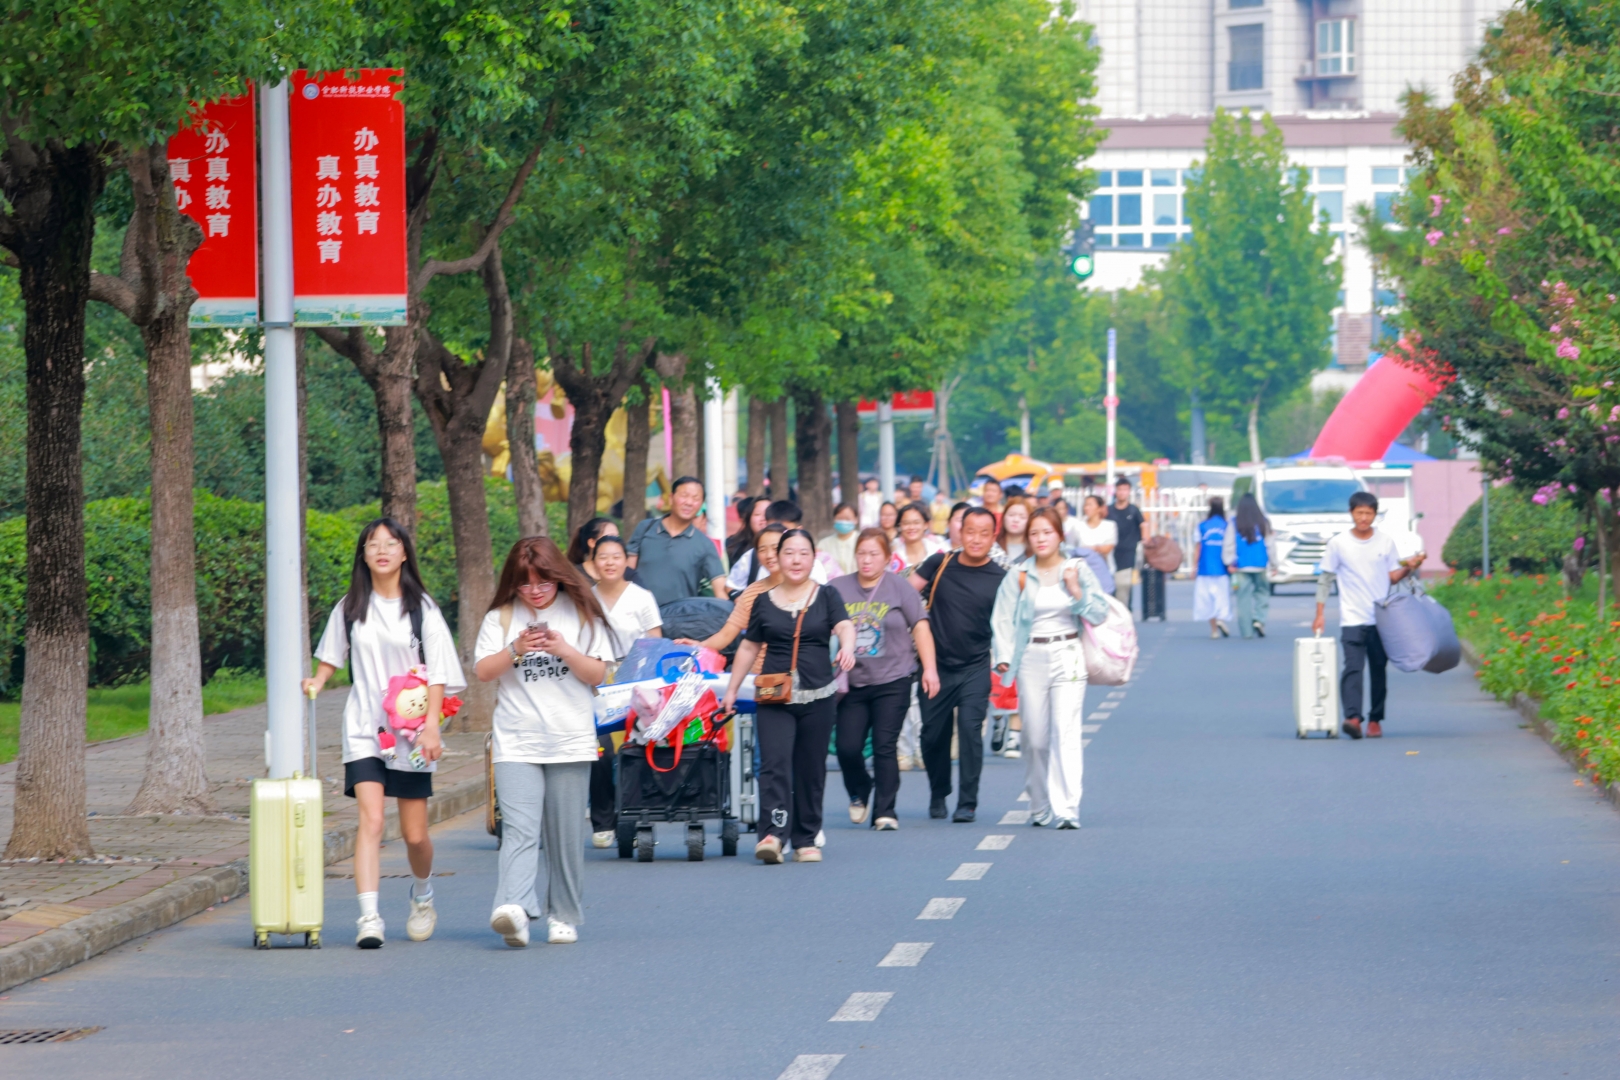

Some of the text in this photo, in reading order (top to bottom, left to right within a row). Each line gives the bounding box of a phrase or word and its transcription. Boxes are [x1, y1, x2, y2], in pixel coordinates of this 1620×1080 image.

[205, 128, 231, 237] 办真教育
[316, 155, 343, 264] 真办教育
[354, 127, 380, 235] 办真教育
[524, 666, 569, 682] People
